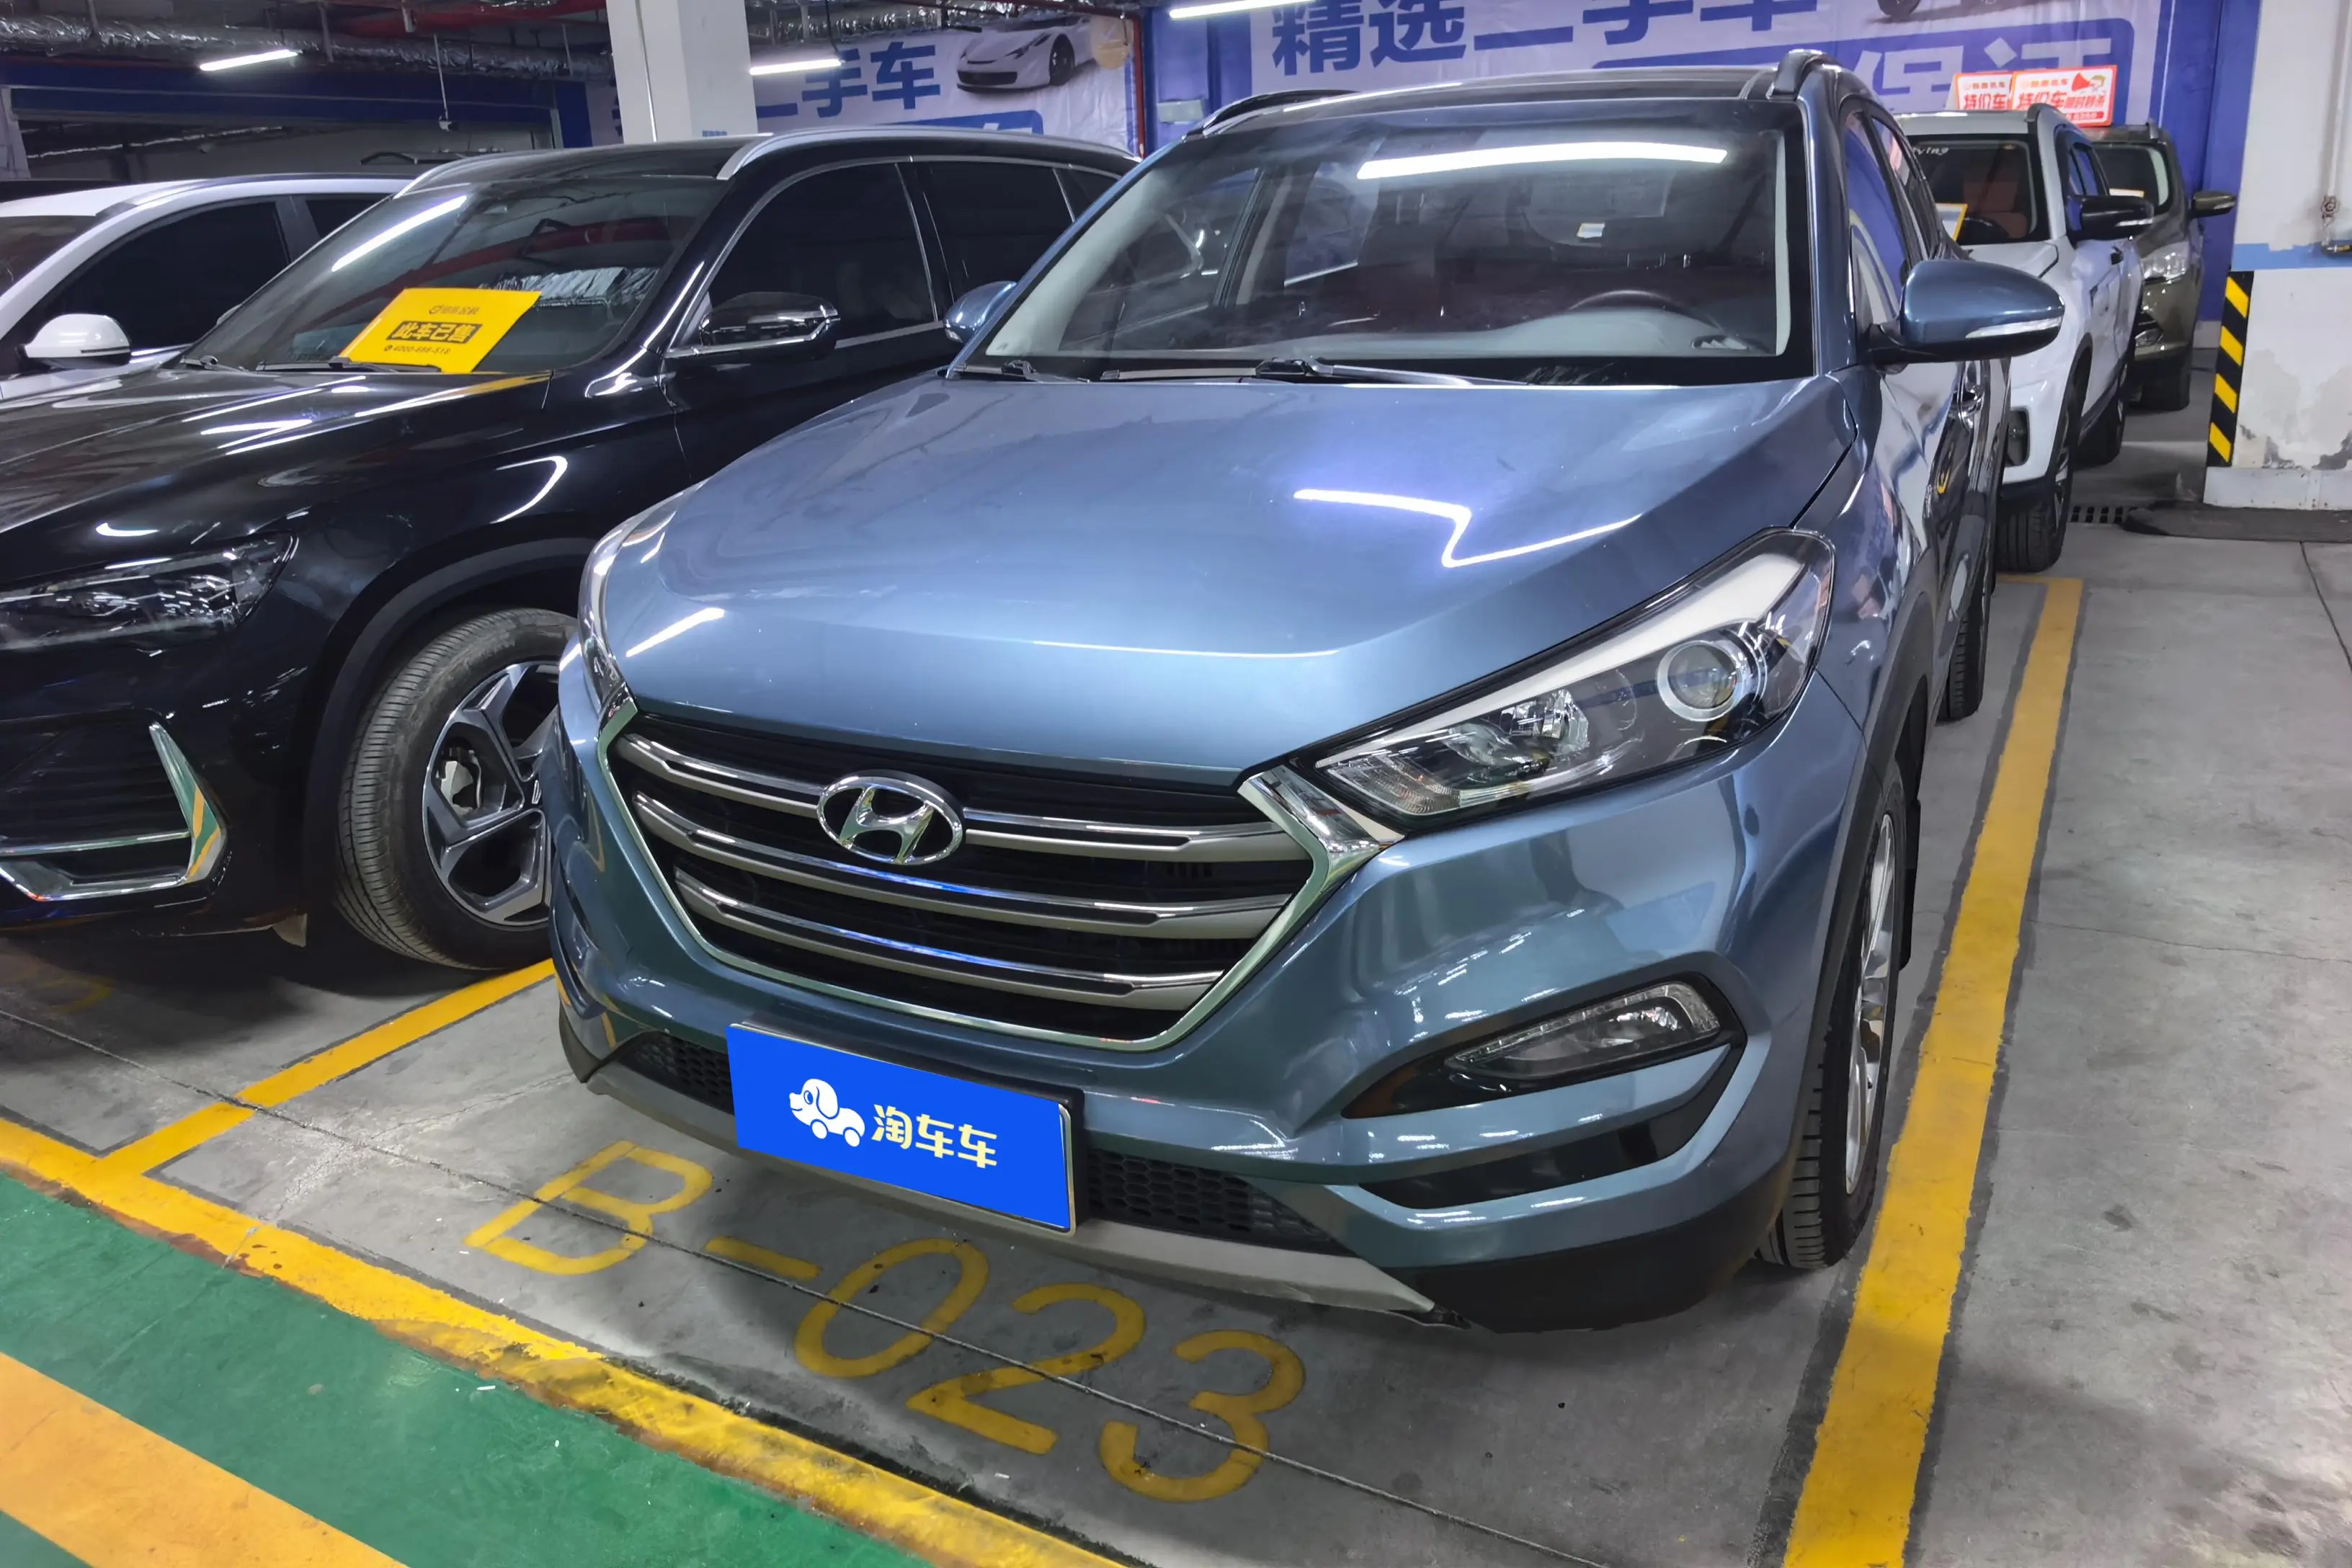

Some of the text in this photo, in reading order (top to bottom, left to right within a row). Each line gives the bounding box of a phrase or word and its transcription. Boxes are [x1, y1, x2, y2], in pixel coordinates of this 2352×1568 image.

[391, 321, 476, 343] 此车已售
[463, 1140, 1306, 1503] B-023
